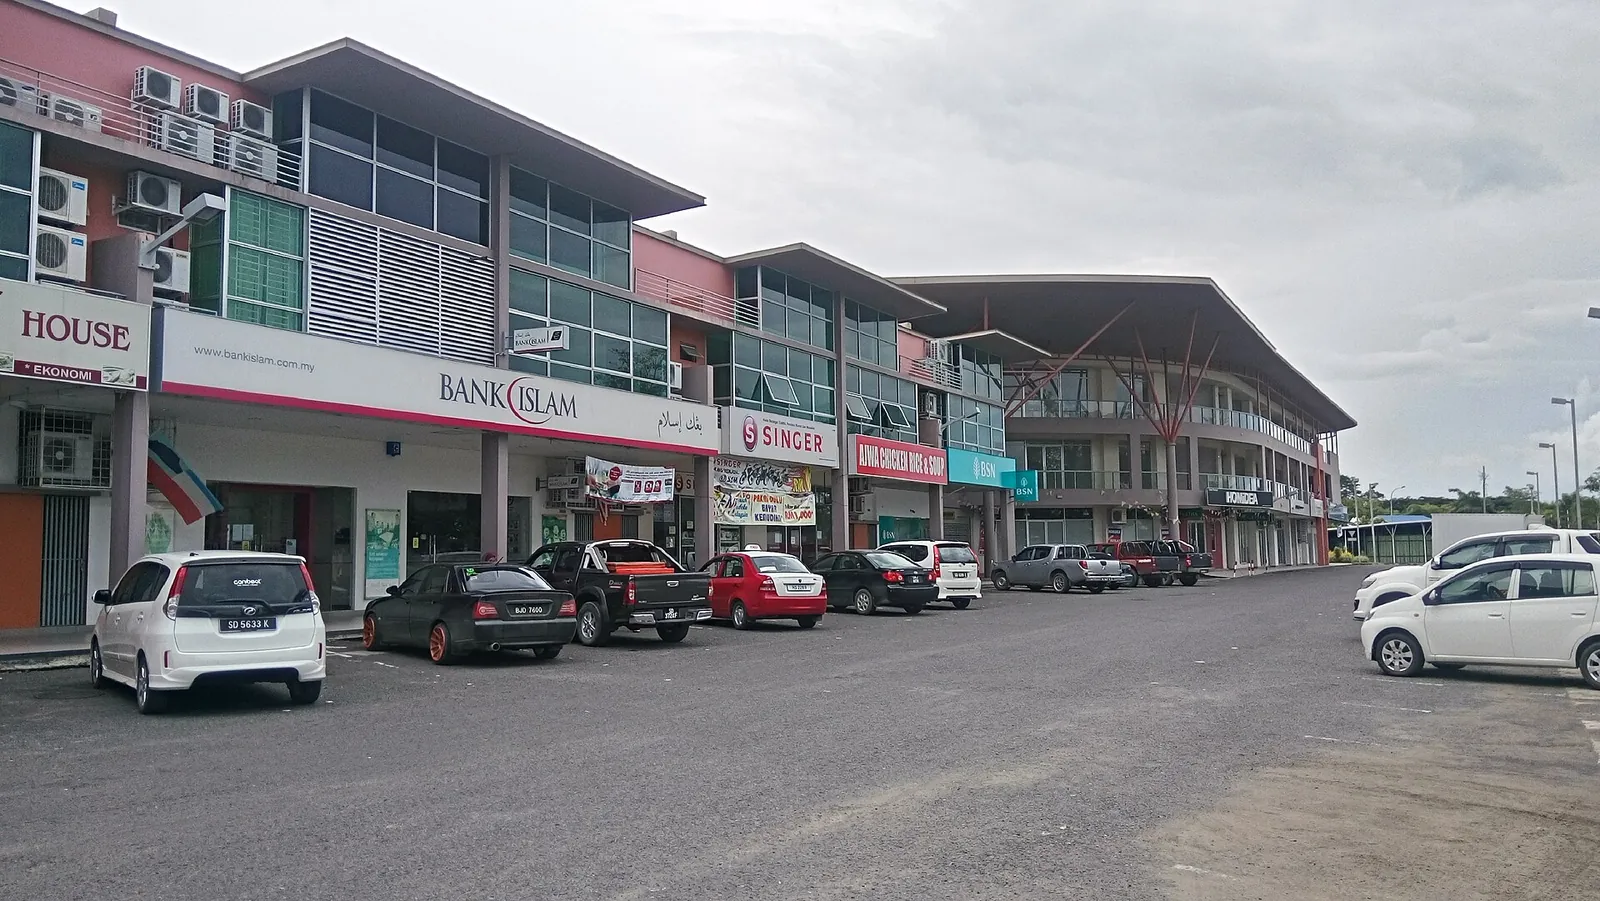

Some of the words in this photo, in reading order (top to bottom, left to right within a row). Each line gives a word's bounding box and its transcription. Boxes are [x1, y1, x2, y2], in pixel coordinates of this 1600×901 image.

[22, 309, 131, 351] HOUSE
[33, 365, 92, 381] EKONOMI
[194, 346, 315, 373] www.bankislam.com.my
[439, 372, 507, 409] BANK
[518, 385, 578, 418] ISLAM
[762, 425, 823, 453] SINGER
[859, 443, 880, 468] AJWA
[880, 447, 909, 471] CHICKEN
[908, 451, 923, 473] RICE
[923, 457, 929, 474] &
[928, 455, 944, 476] SOUP
[980, 460, 996, 478] BSN
[1016, 487, 1033, 495] BSN
[228, 620, 239, 629] SD
[240, 620, 262, 629] 5633
[263, 619, 270, 628] K
